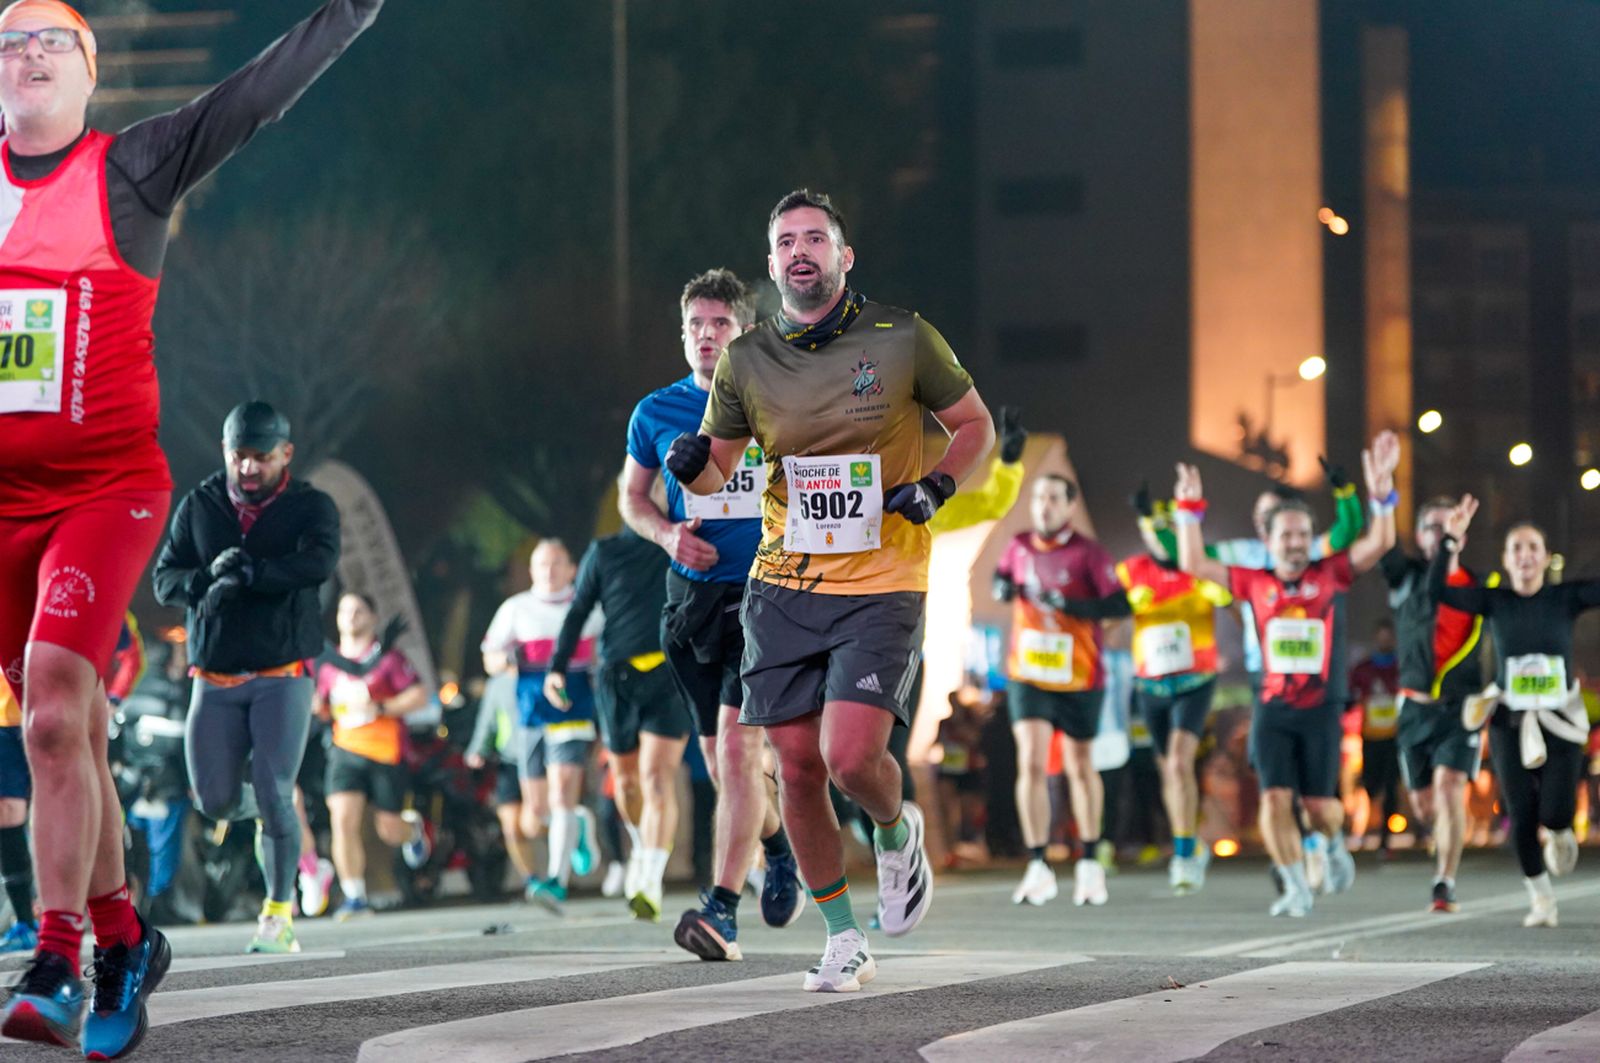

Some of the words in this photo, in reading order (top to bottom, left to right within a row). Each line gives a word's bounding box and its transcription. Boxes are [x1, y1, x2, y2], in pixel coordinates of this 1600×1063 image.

[719, 470, 755, 493] 35
[828, 467, 840, 477] DE
[806, 475, 842, 490] ANTÓN
[799, 490, 864, 521] 5902
